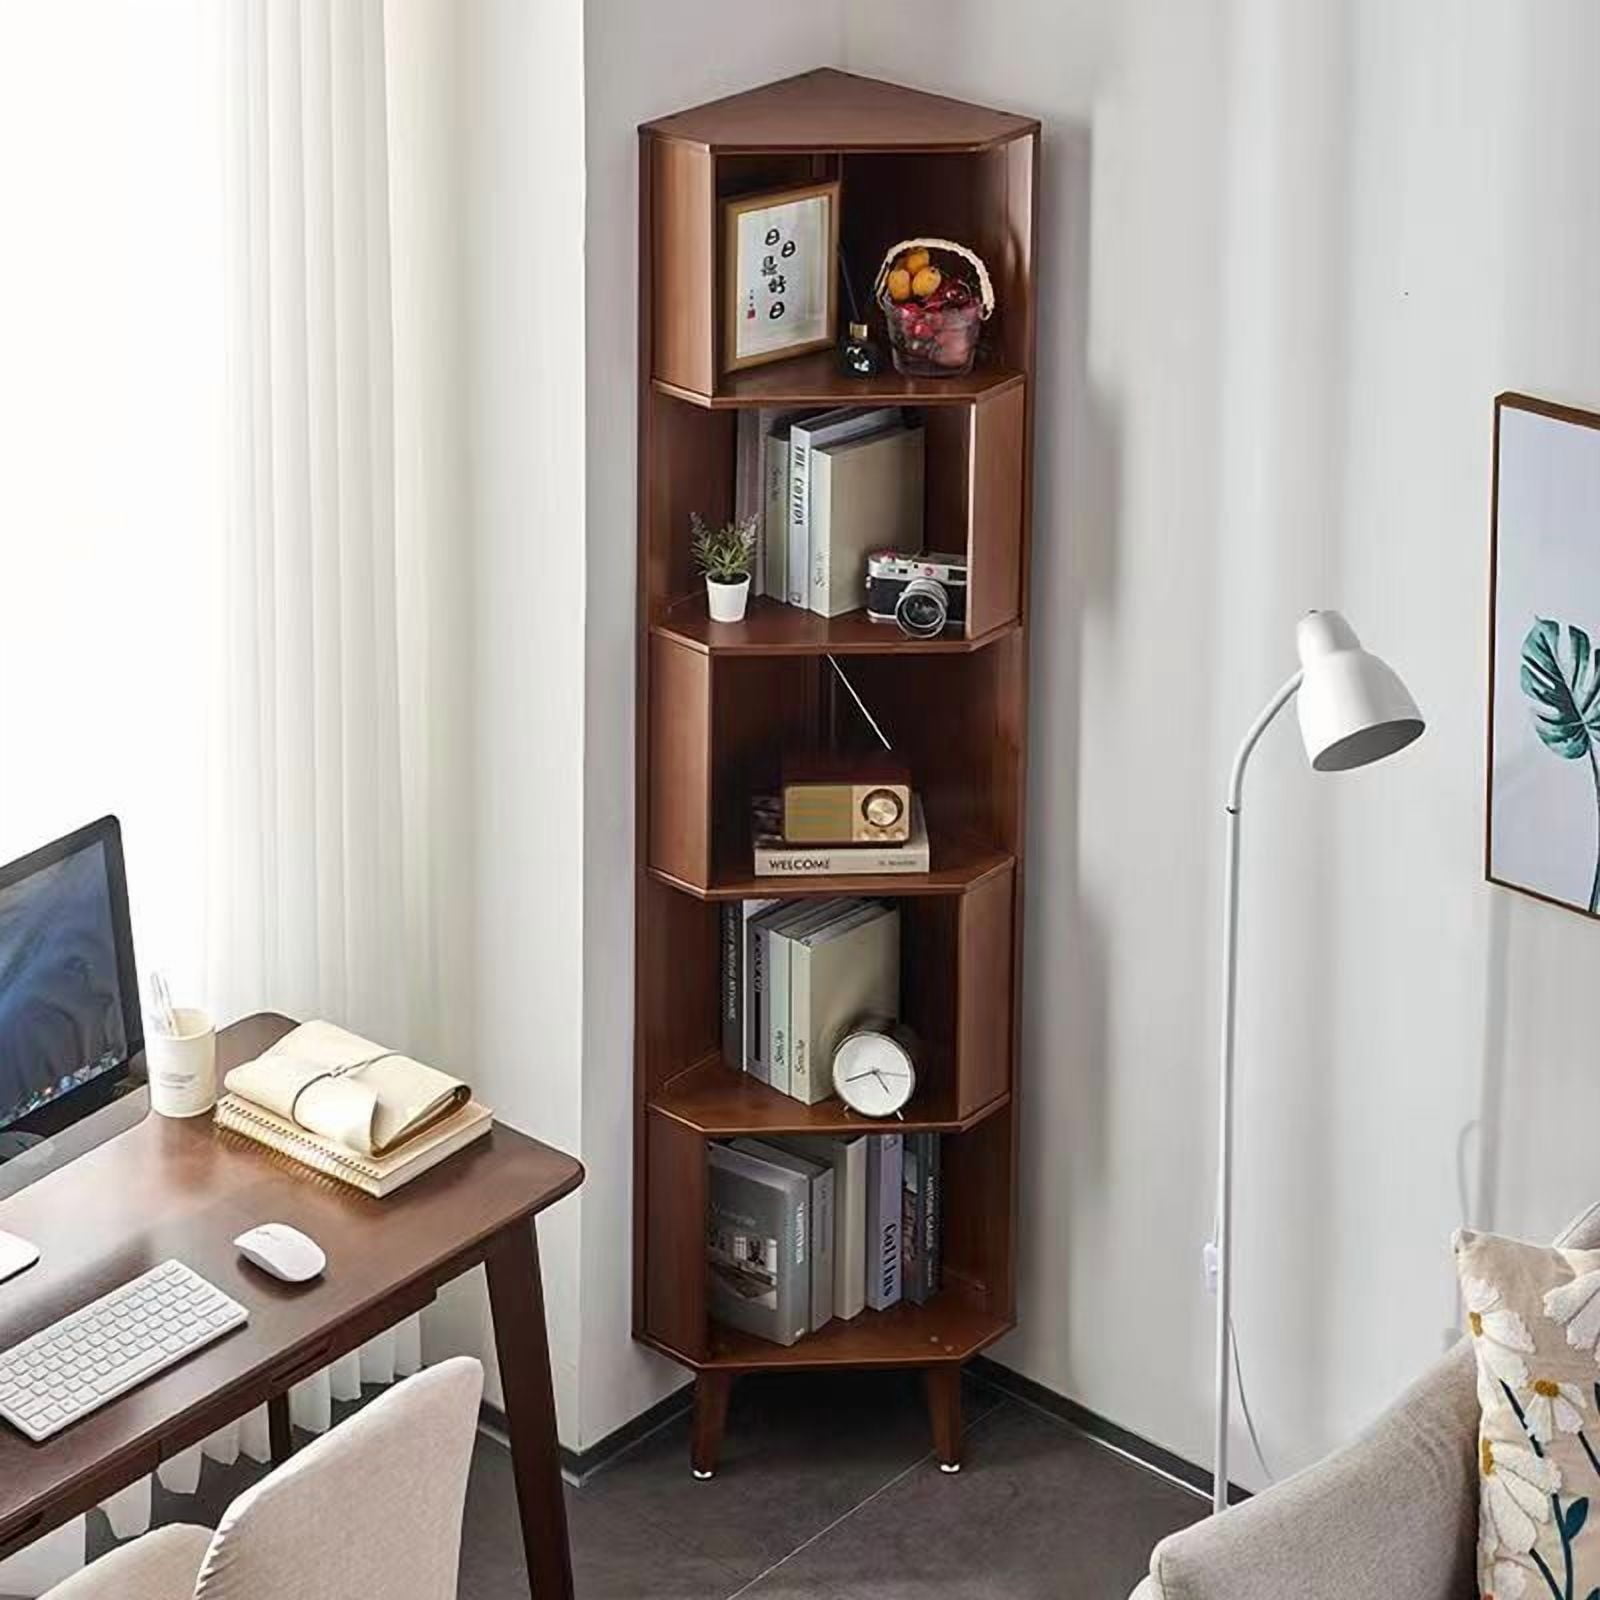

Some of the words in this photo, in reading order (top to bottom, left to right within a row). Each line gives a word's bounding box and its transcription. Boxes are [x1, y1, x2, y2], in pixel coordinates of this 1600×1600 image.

[794, 446, 806, 468] THE
[768, 858, 830, 871] WELCOME
[883, 1223, 897, 1297] Collins
